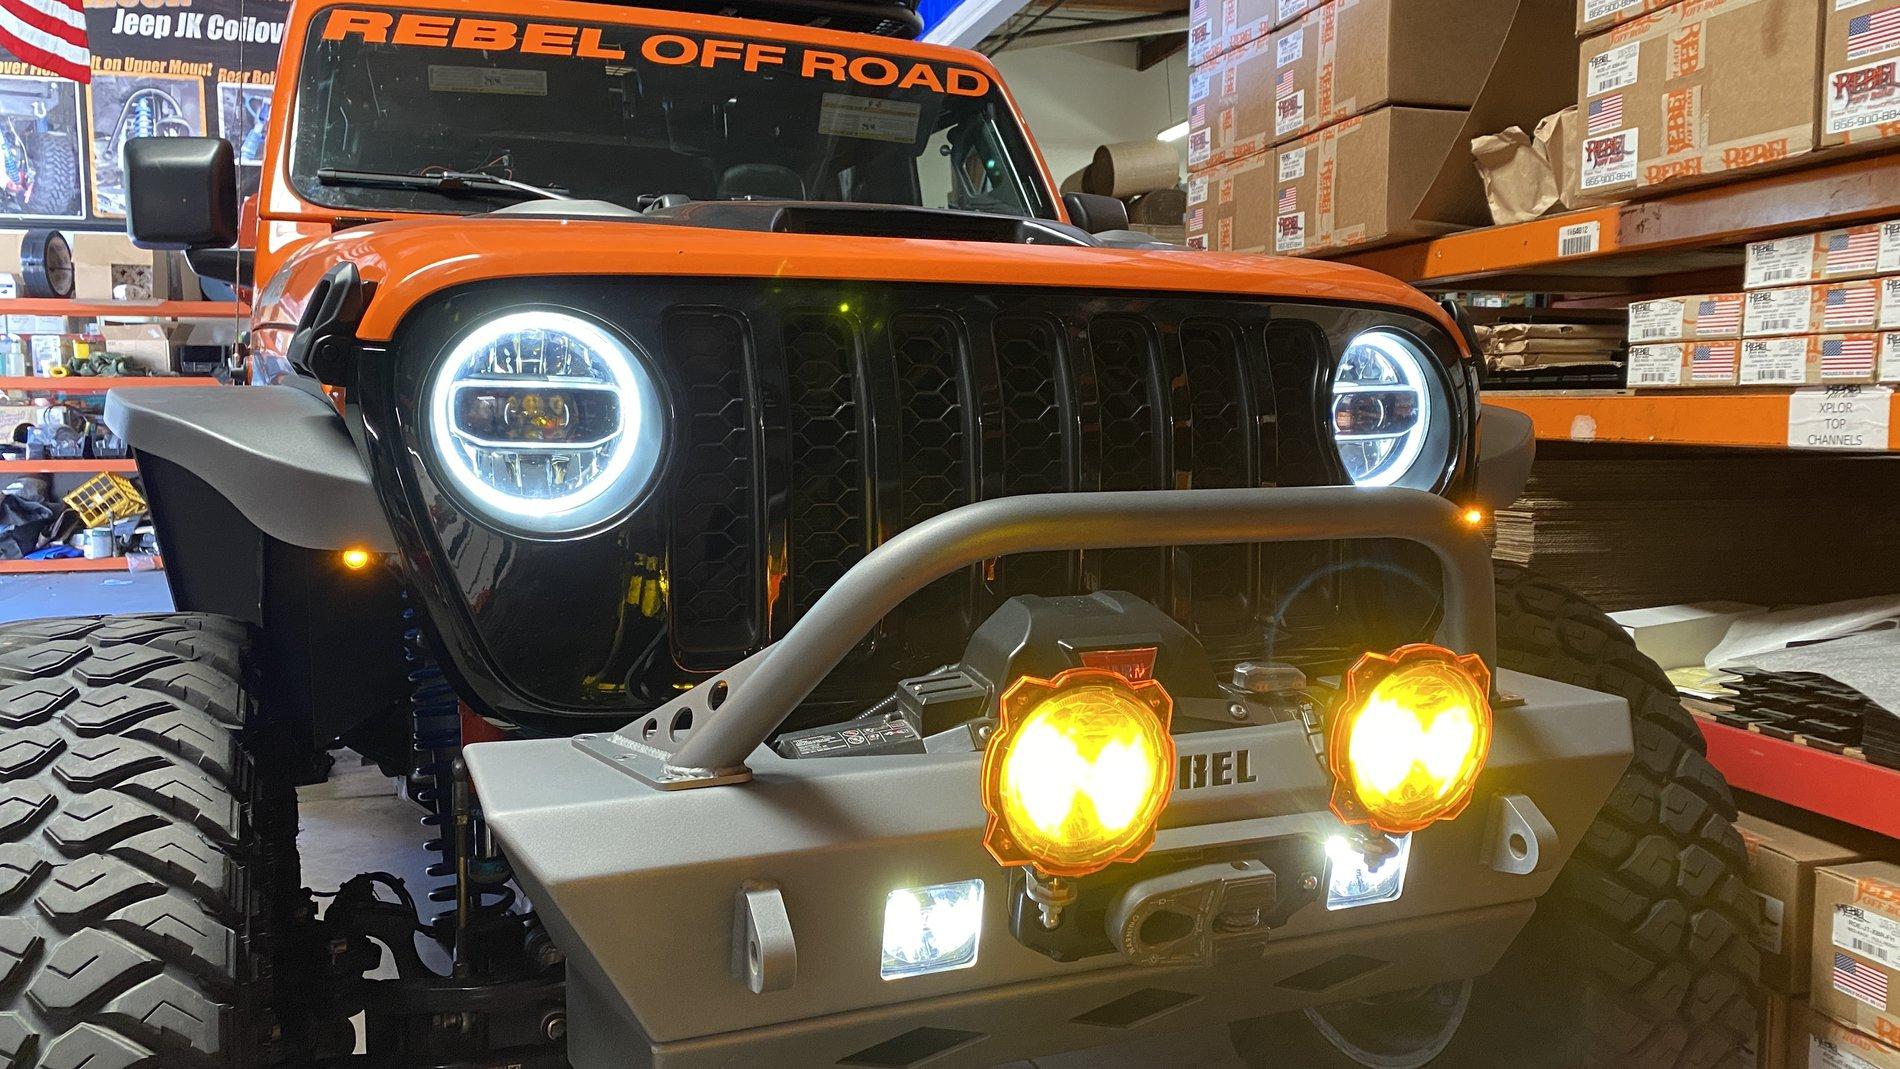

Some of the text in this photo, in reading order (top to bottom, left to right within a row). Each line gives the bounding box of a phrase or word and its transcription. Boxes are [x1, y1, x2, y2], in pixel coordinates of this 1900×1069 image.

[112, 9, 285, 44] Jeep JK Coilov
[103, 59, 122, 72] on
[124, 56, 166, 74] Upper
[169, 59, 213, 77] Mount
[322, 9, 990, 97] REBEL OFF ROAD
[217, 68, 277, 85] Rear Bol
[1833, 62, 1900, 105] REBEL
[1586, 134, 1635, 166] REBEL
[1722, 138, 1788, 169] REBEL
[1645, 157, 1702, 184] REBEL
[1819, 402, 1853, 414] XPLOR
[1825, 418, 1847, 430] TOP
[1808, 434, 1863, 446] CHANNELS
[1172, 749, 1259, 791] BEL
